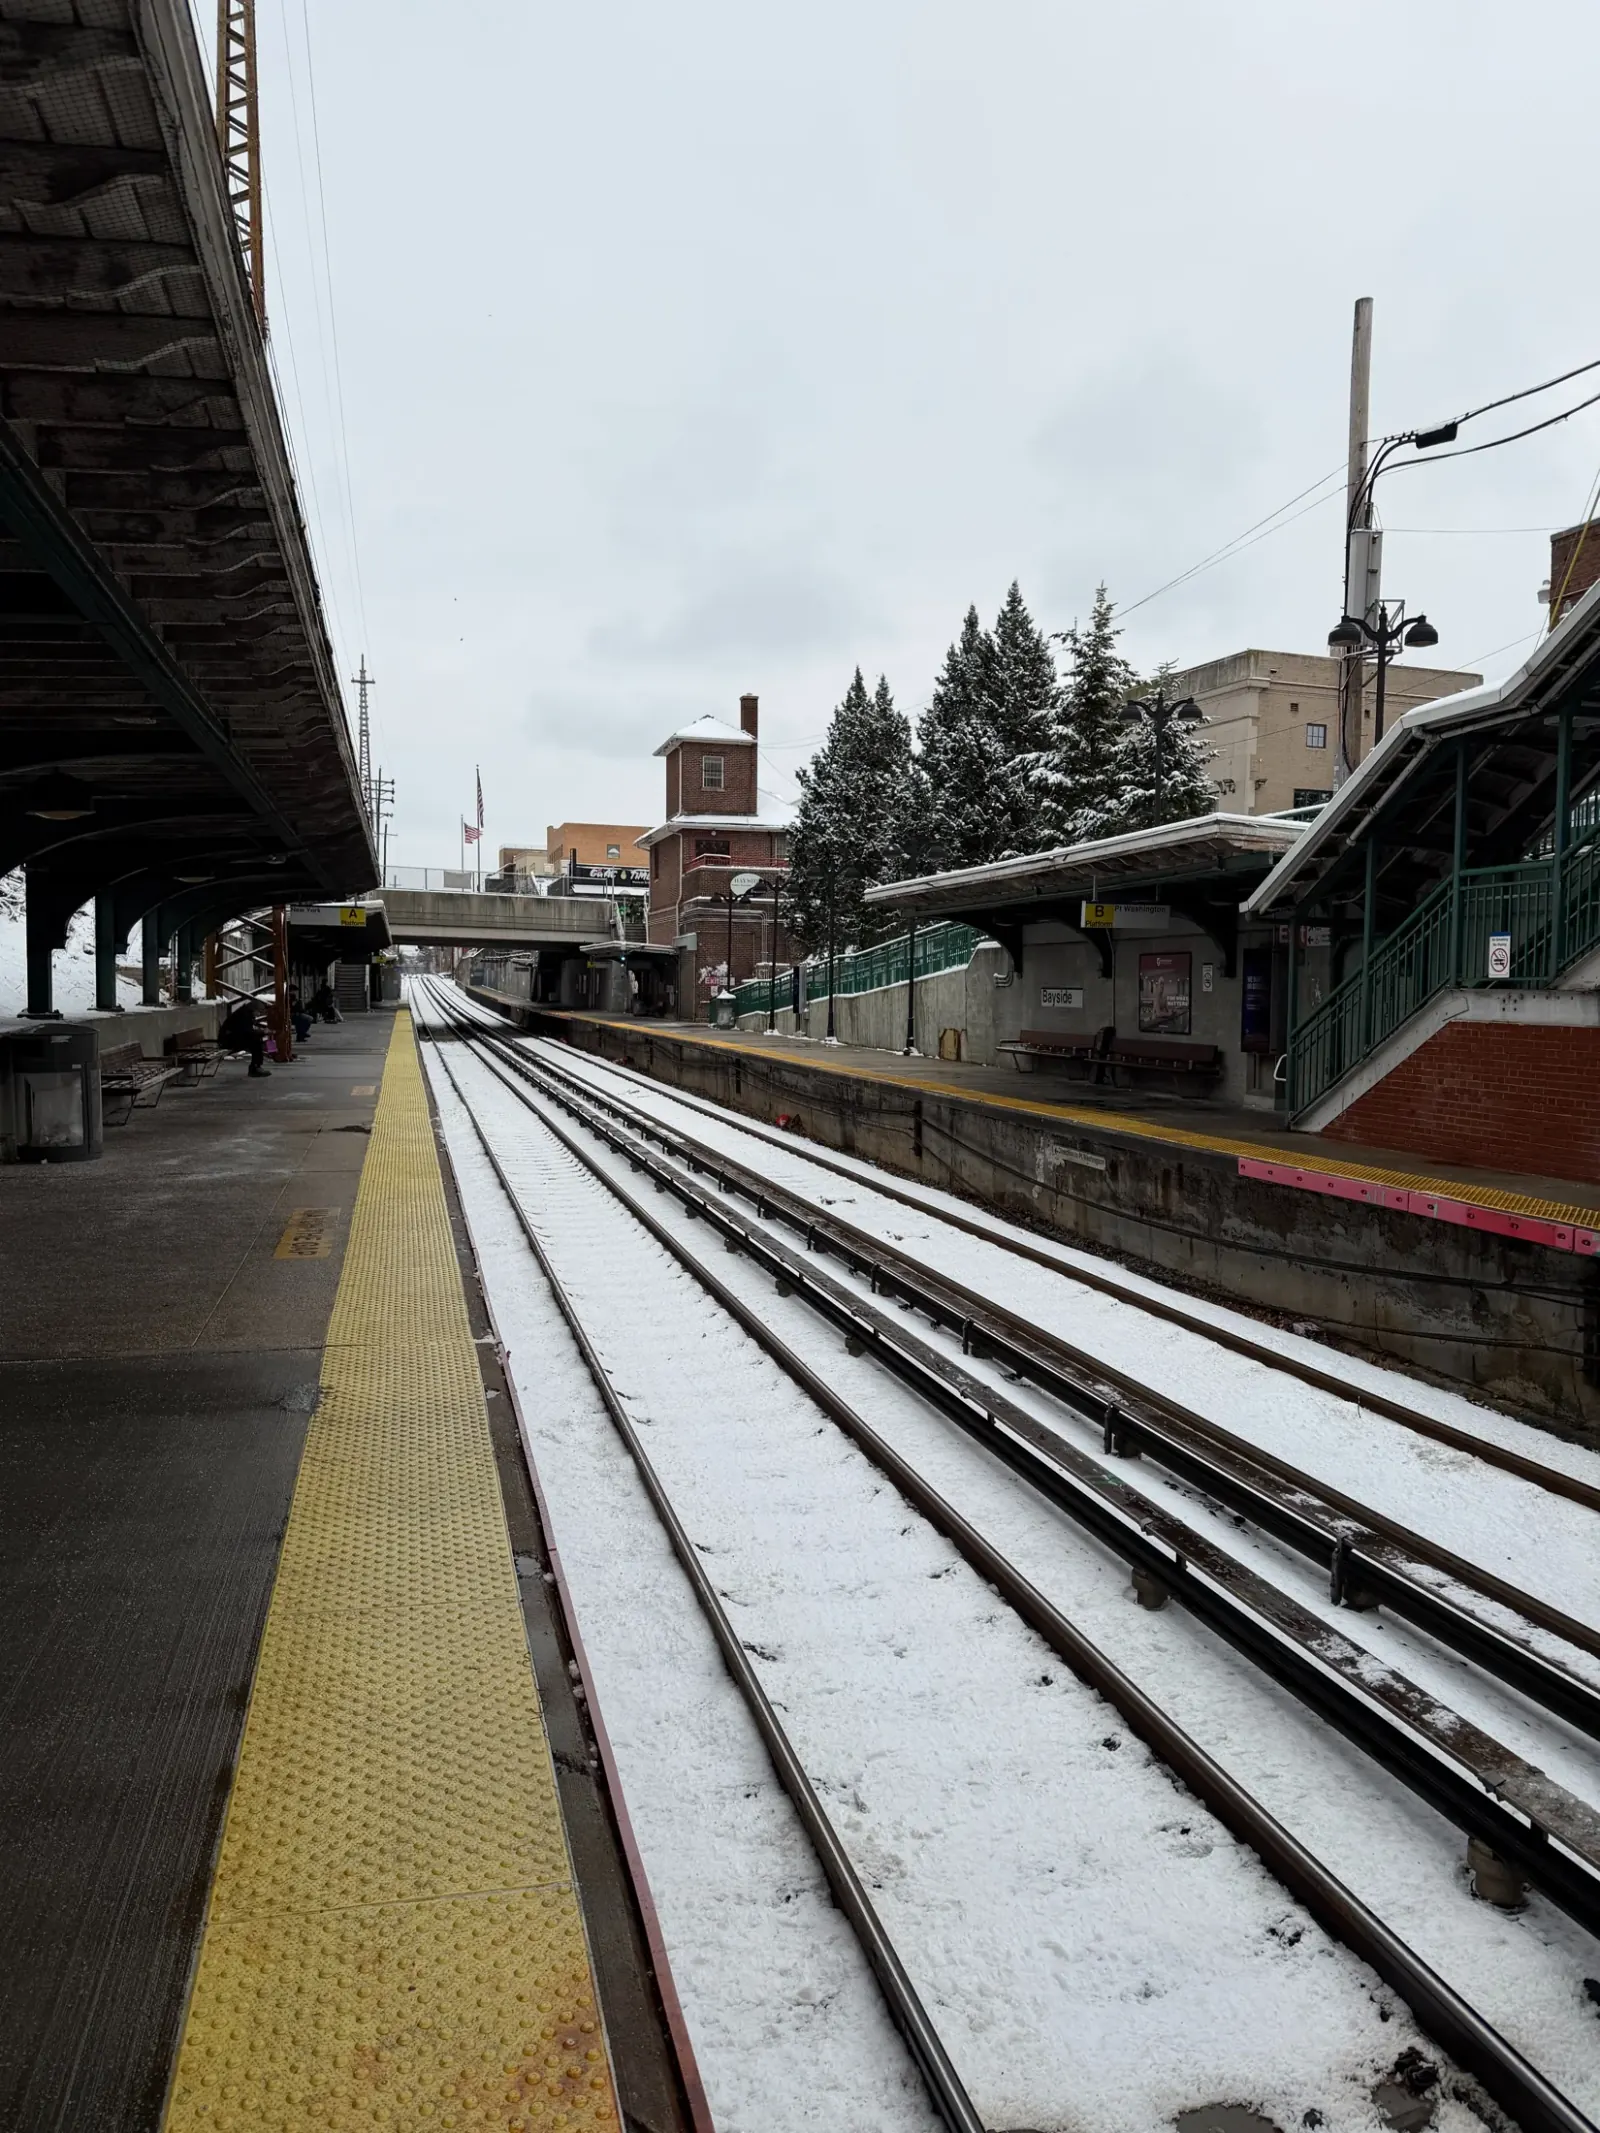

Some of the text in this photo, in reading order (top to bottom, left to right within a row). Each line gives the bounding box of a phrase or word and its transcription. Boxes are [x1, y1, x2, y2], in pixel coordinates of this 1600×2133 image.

[349, 908, 358, 918] A
[1095, 905, 1105, 918] B
[1124, 905, 1166, 913] Washington
[1085, 920, 1113, 928] Platform
[1042, 989, 1073, 1007] Bayside
